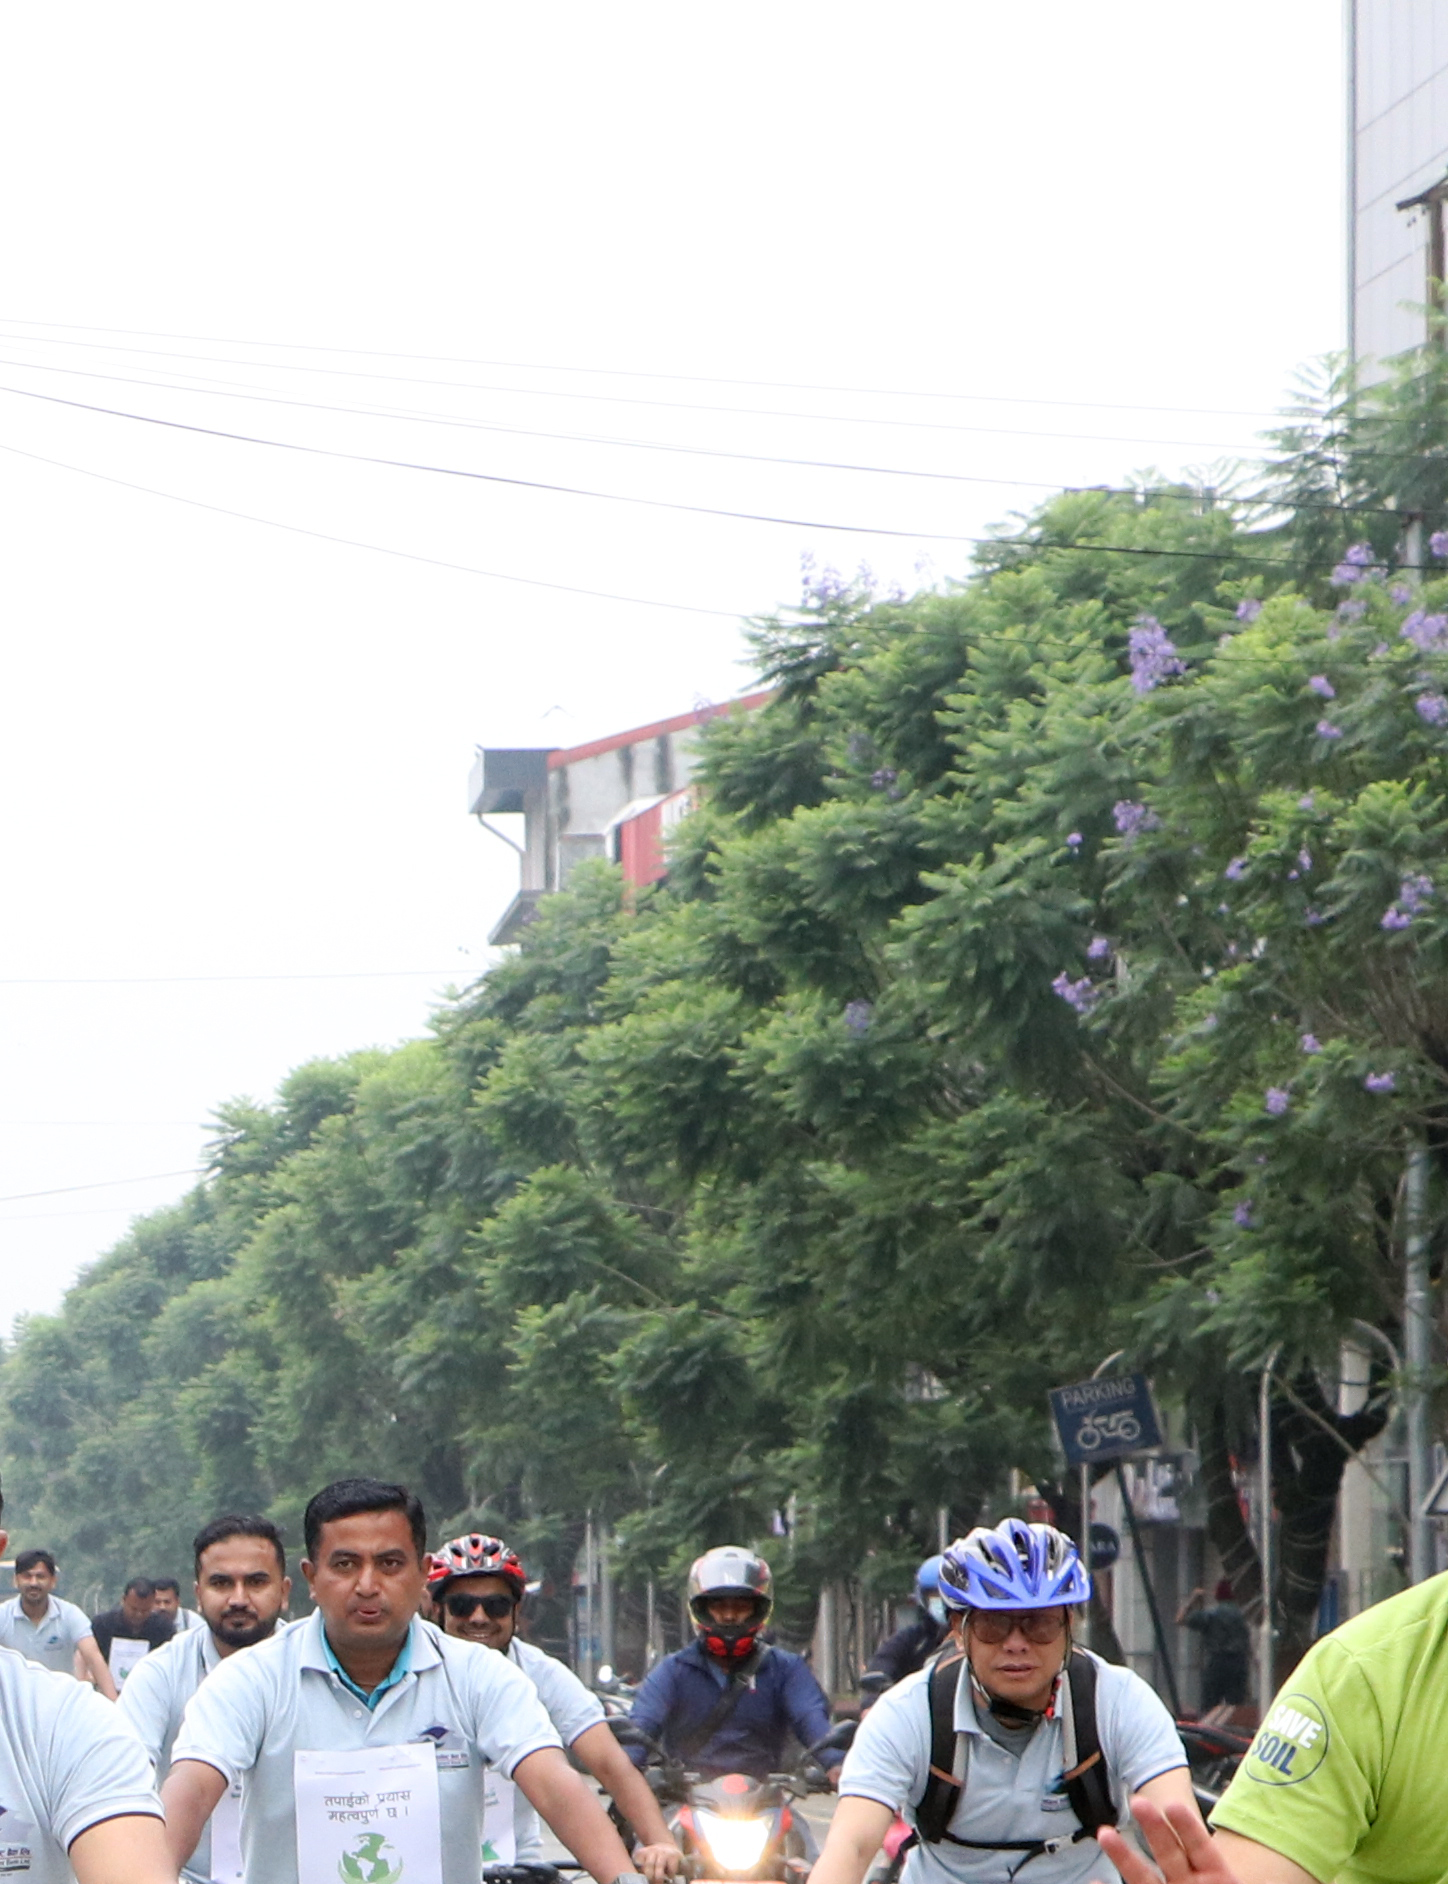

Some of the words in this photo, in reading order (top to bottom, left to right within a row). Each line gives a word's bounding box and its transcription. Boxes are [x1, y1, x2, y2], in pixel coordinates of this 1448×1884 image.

[1062, 1376, 1137, 1410] PARKING
[1268, 1704, 1323, 1750] SAVE
[1253, 1731, 1298, 1776] SOIL
